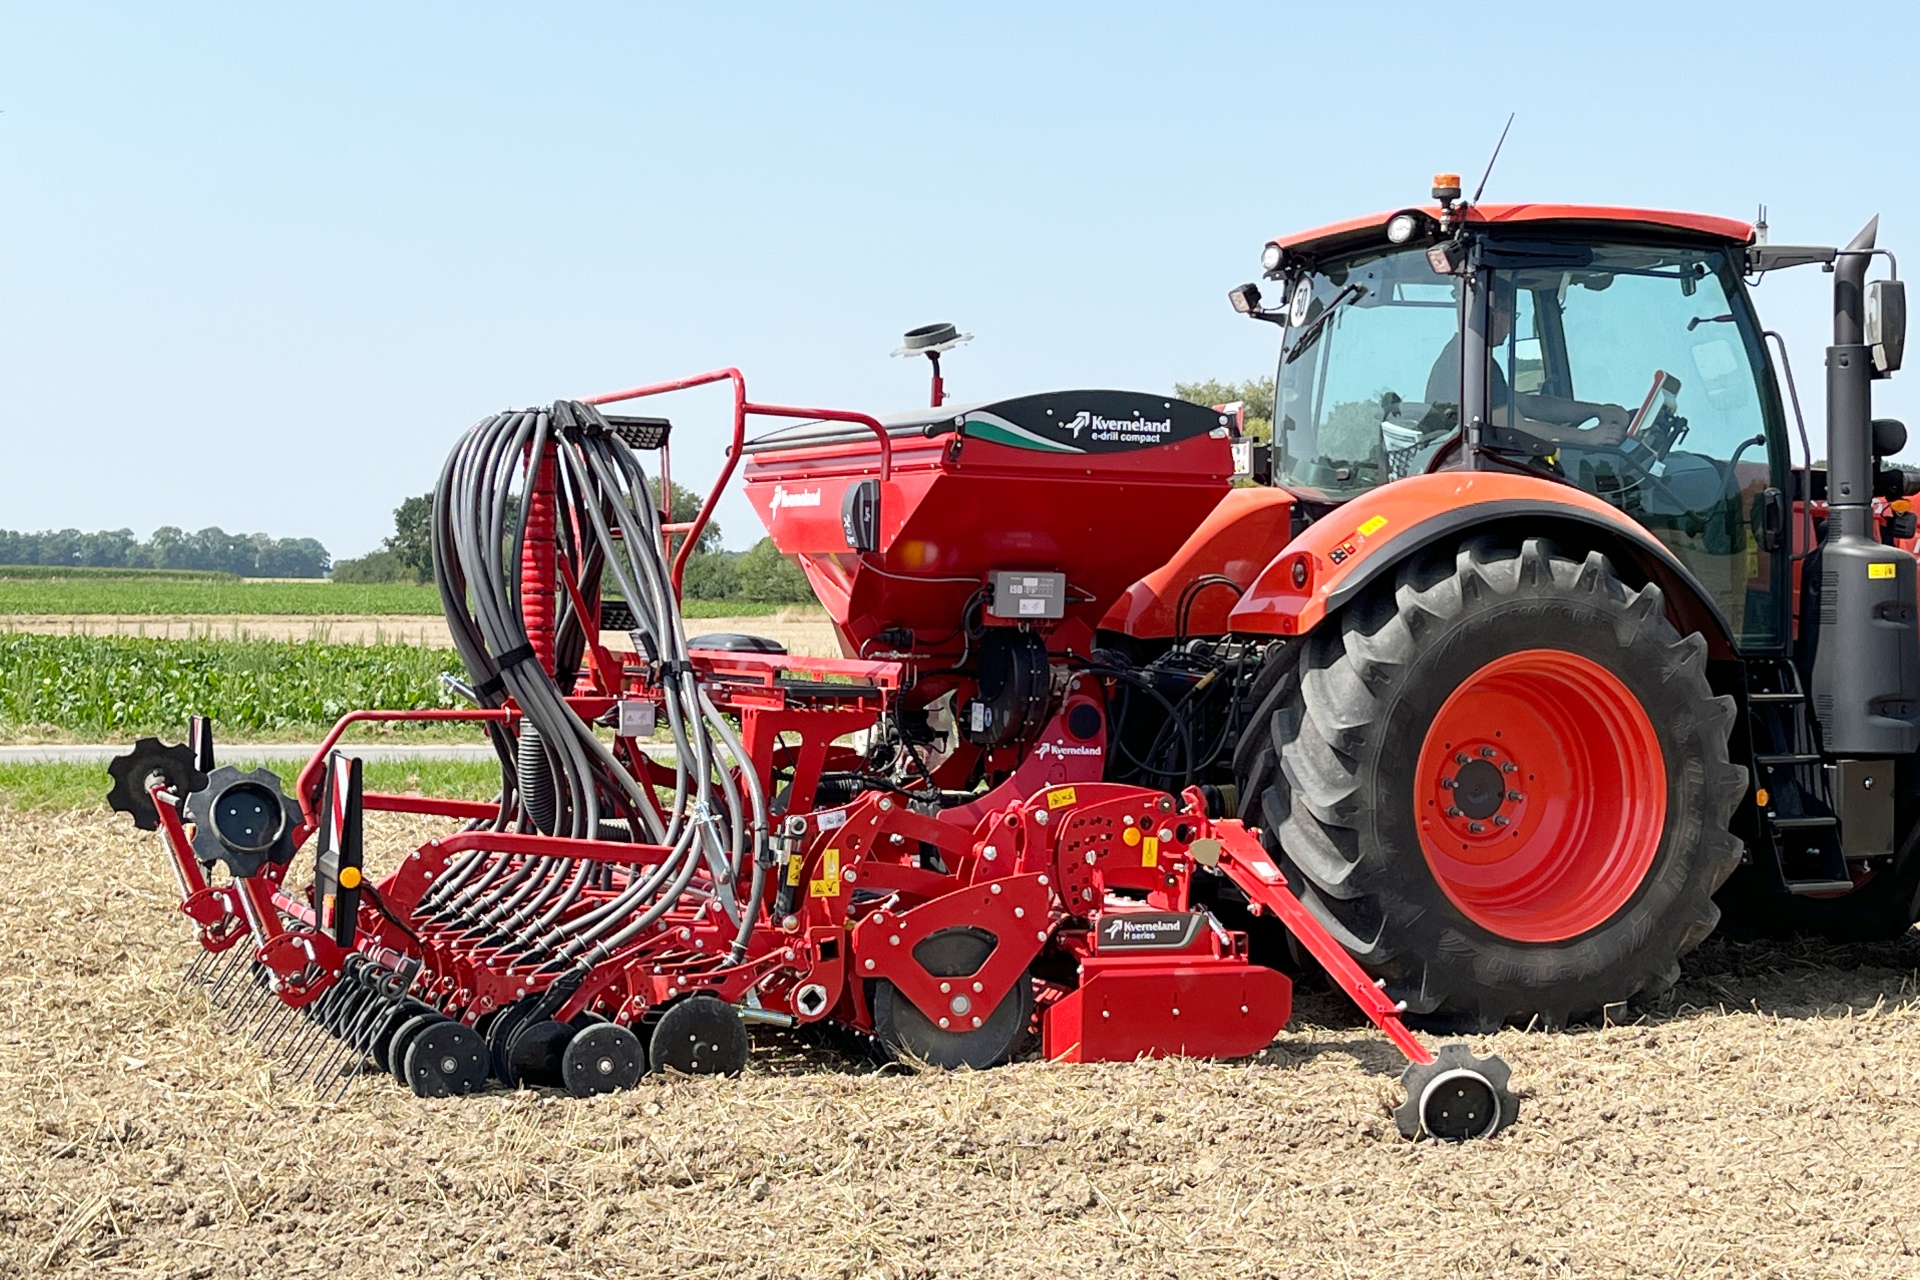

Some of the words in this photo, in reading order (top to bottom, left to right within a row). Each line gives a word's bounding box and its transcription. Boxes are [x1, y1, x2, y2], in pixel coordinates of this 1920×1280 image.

[1295, 288, 1308, 317] 50
[1092, 416, 1171, 432] Kverneland
[1092, 432, 1118, 441] e-drill
[1121, 434, 1160, 443] compact
[1051, 746, 1101, 755] Kverneland
[1123, 920, 1180, 931] Kverneland
[1131, 932, 1155, 940] series
